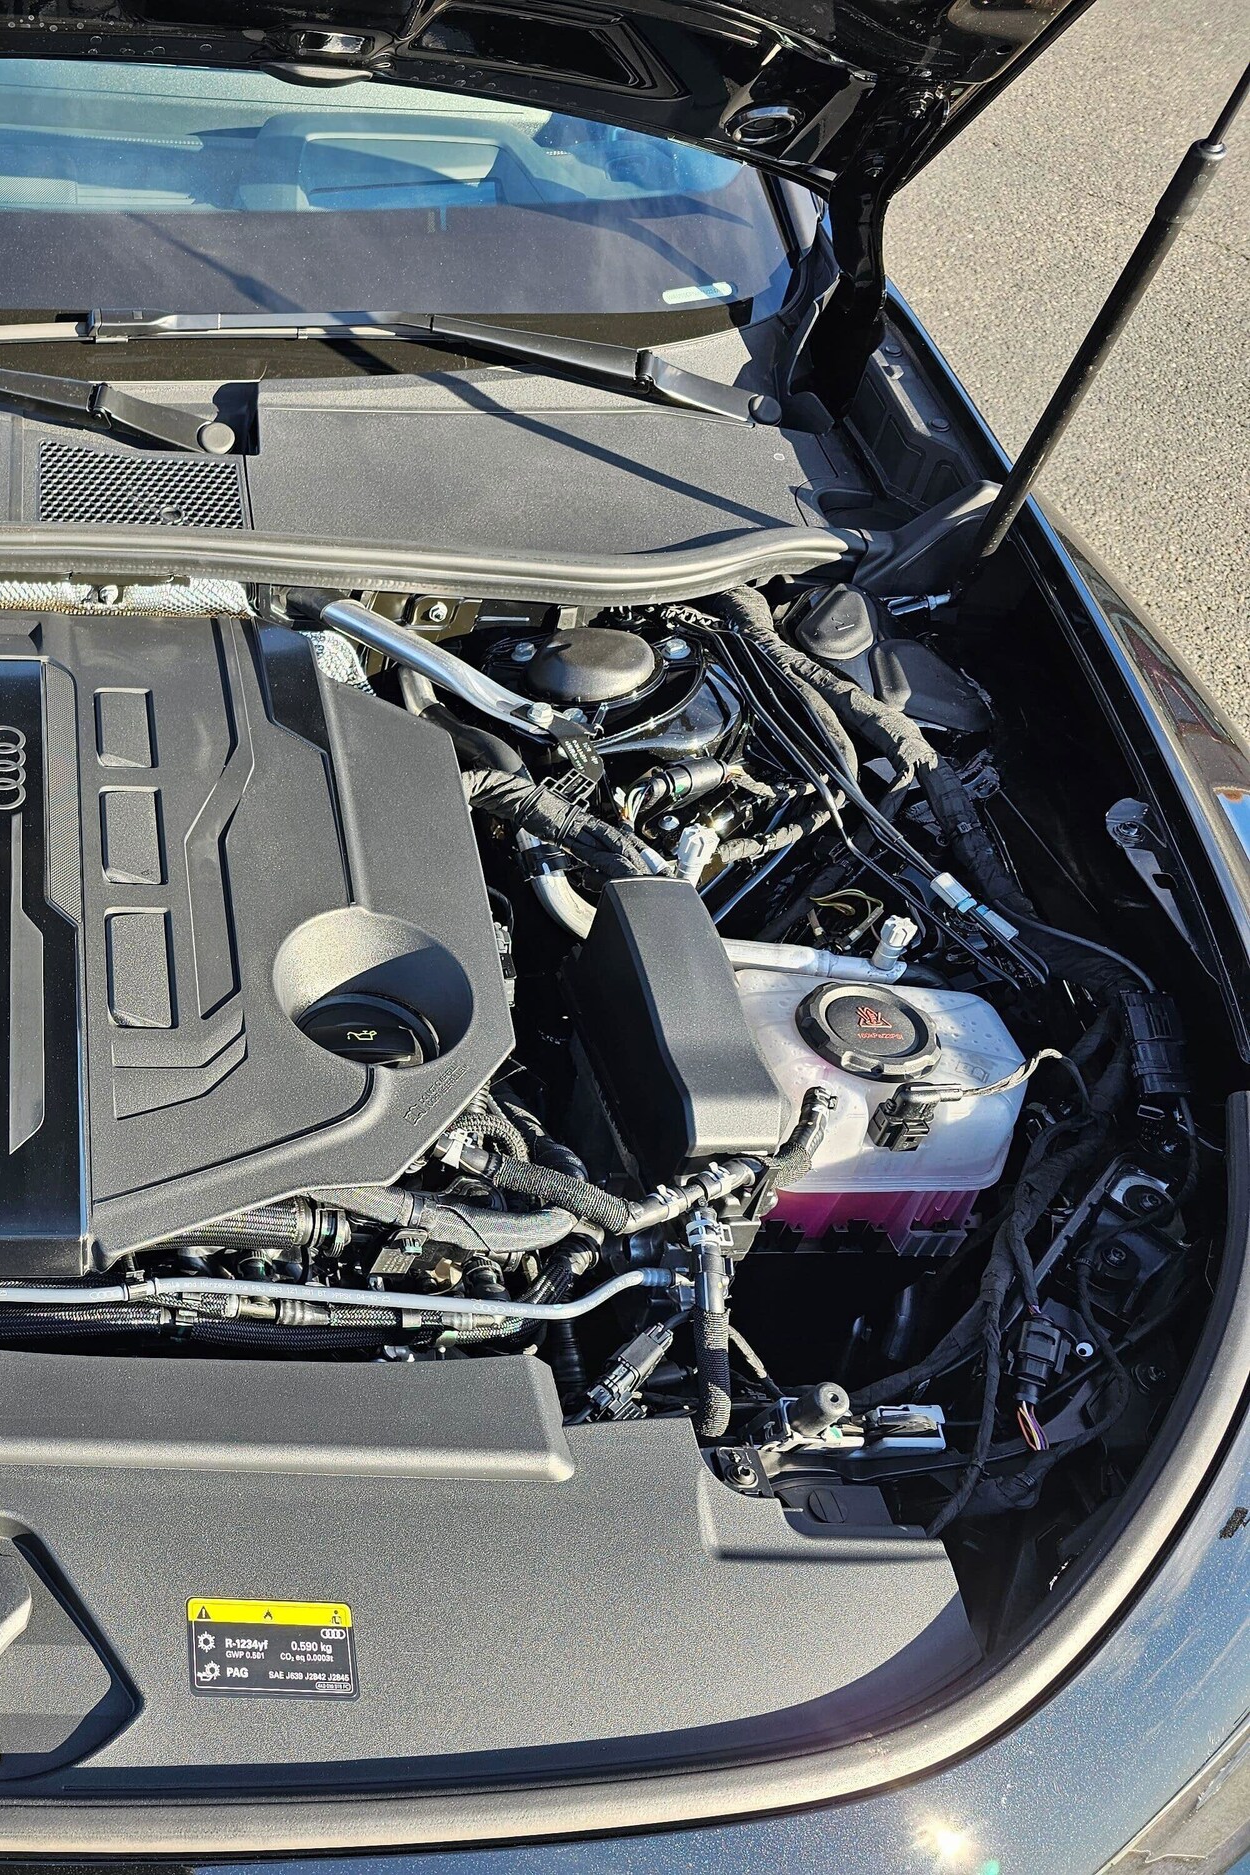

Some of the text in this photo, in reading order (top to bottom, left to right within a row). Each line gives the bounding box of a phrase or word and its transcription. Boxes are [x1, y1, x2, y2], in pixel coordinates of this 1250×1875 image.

[225, 1638, 268, 1651] R-1234yf
[291, 1641, 332, 1654] 0.590 kg
[225, 1650, 244, 1658] GWP
[226, 1667, 249, 1678] PAG
[286, 1672, 303, 1680] J639
[305, 1672, 327, 1680] J2842
[327, 1673, 350, 1682] J2845
